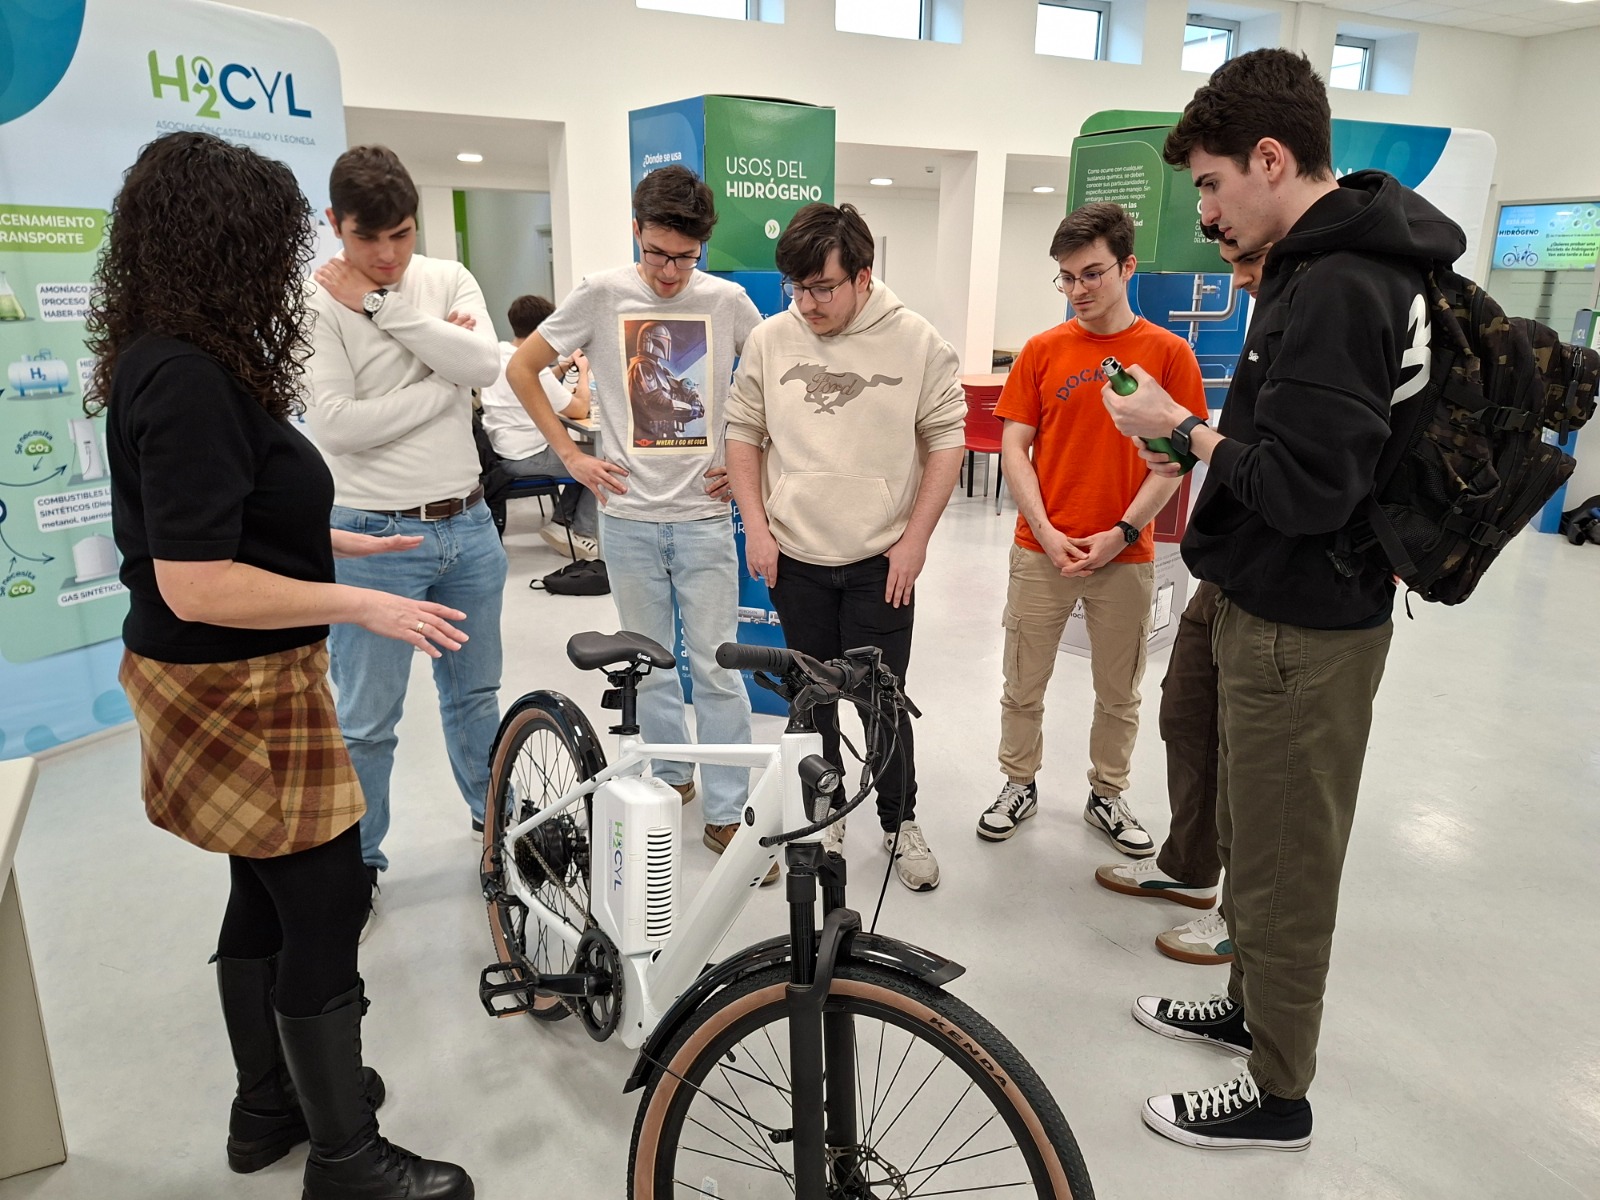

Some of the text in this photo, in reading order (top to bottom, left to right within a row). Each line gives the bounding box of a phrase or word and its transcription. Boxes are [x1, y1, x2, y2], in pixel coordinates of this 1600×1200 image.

[215, 126, 271, 141] CASTELLANO
[273, 133, 278, 141] Y
[279, 134, 316, 146] LEONESA
[643, 151, 682, 168] ¿Dónde se usa
[726, 156, 807, 179] USOS DEL
[1122, 165, 1144, 173] cualquier
[726, 178, 822, 201] HIDRÓGENO
[1085, 188, 1119, 196] especificaciones
[0, 213, 95, 228] CENAMIENTO
[1498, 228, 1539, 236] HIDRÓGENO
[40, 284, 88, 294] AMONÍACO
[42, 298, 86, 306] (PROCESO
[44, 310, 90, 318] HABER-B
[30, 367, 47, 381] H2
[806, 372, 858, 395] Ford
[1056, 369, 1105, 401] DOCK
[28, 444, 50, 454] CO2
[37, 491, 103, 506] COMBUSTIBLES
[39, 500, 112, 518] SINTÉTICOS (Dies
[41, 512, 112, 529] metanol, querose
[11, 584, 32, 595] CO2
[61, 584, 122, 603] GAS SINTÉTICO
[613, 821, 623, 891] H2CYL
[929, 1017, 1007, 1088] KENDA
